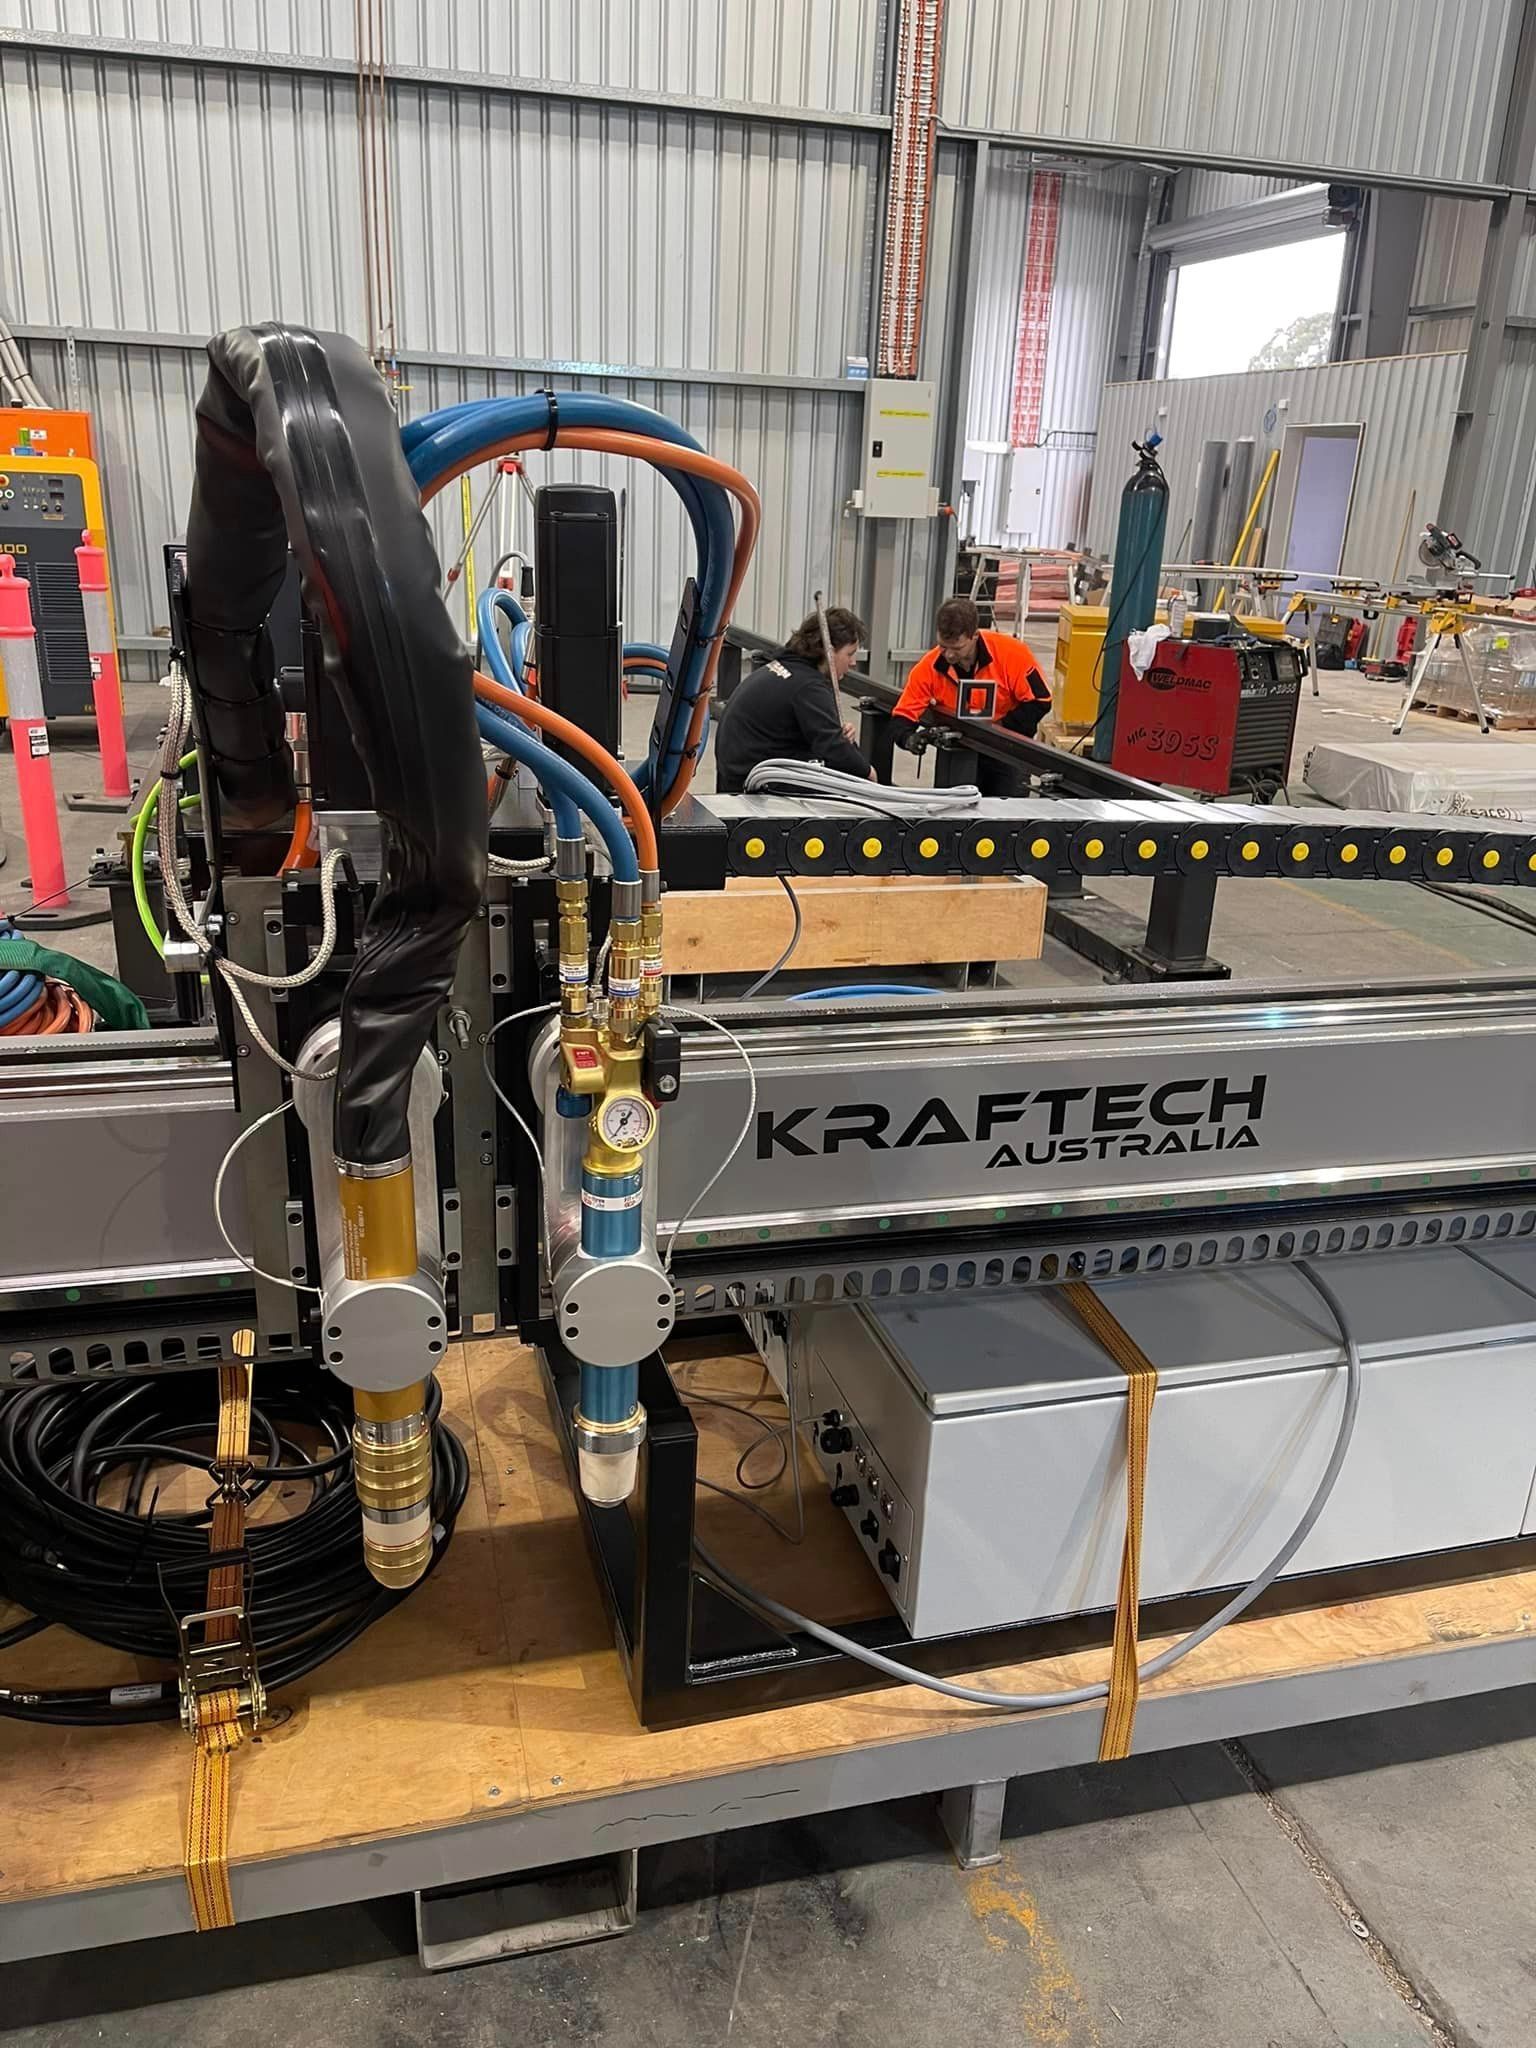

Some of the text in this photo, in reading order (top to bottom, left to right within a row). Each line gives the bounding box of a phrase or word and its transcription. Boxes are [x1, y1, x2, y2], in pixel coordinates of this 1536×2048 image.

[1151, 672, 1212, 690] WELDMAC
[1146, 728, 1220, 761] 395S
[756, 1074, 1268, 1161] KRAFTECH
[984, 1124, 1261, 1169] AUSTRALIA
